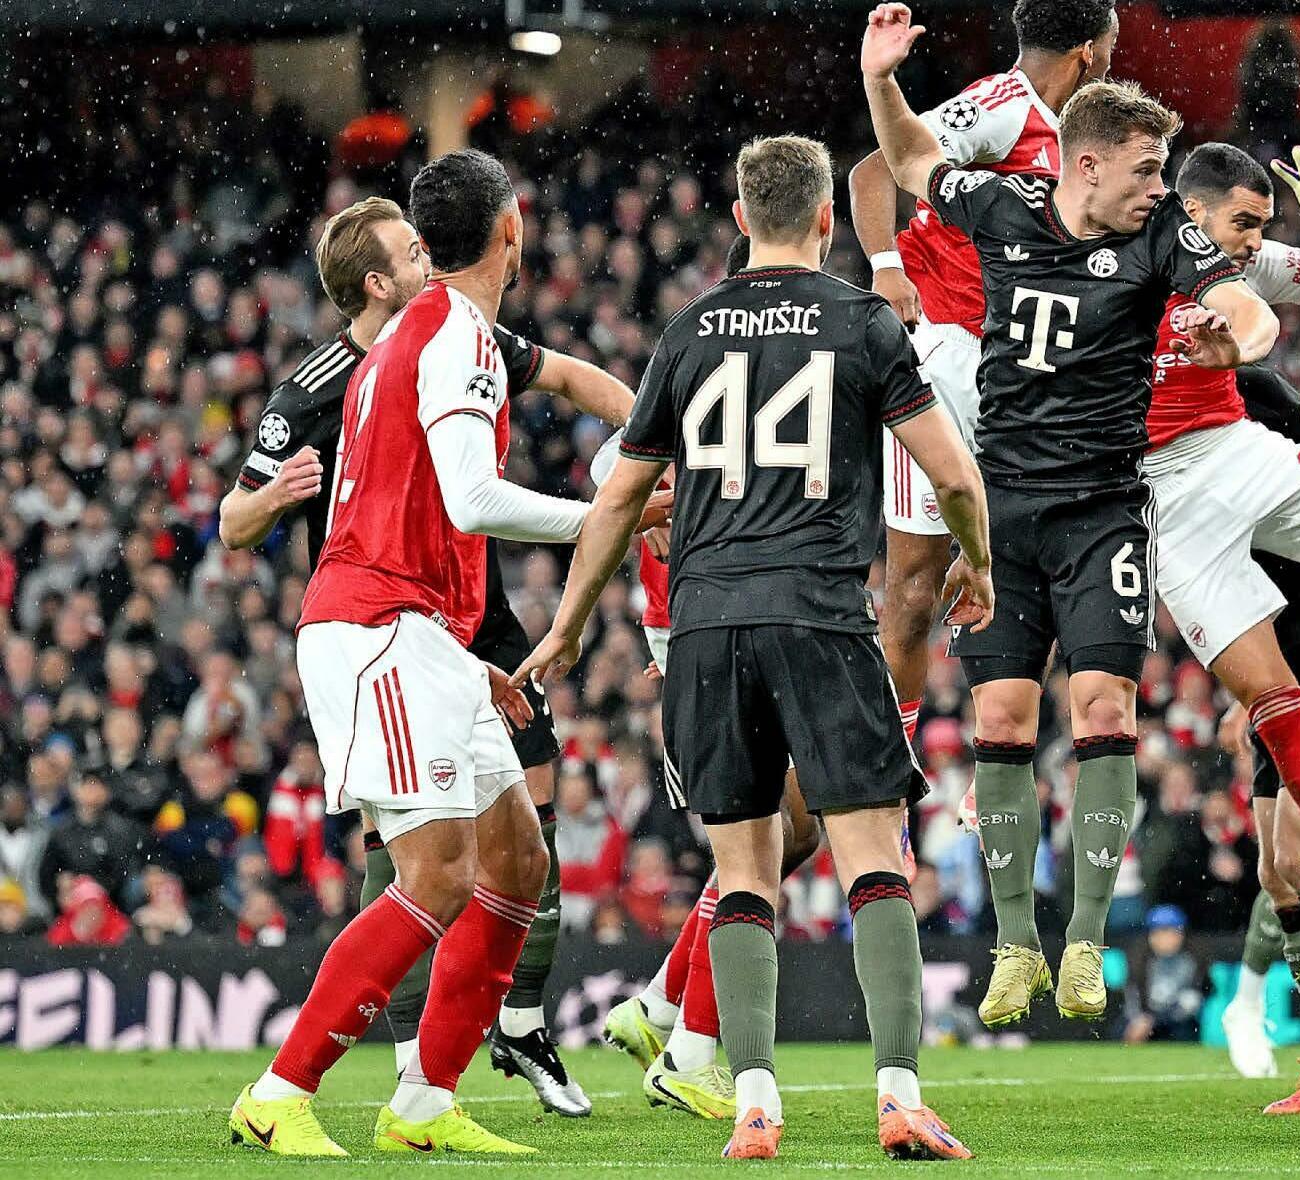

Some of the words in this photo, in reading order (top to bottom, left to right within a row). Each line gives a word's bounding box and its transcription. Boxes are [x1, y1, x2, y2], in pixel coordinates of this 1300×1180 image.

[697, 301, 822, 338] STANIŠIĆ
[1009, 287, 1080, 373] T
[682, 351, 836, 500] 44
[1110, 541, 1142, 597] 6
[979, 813, 1018, 827] CBM
[1084, 812, 1128, 832] FCBM
